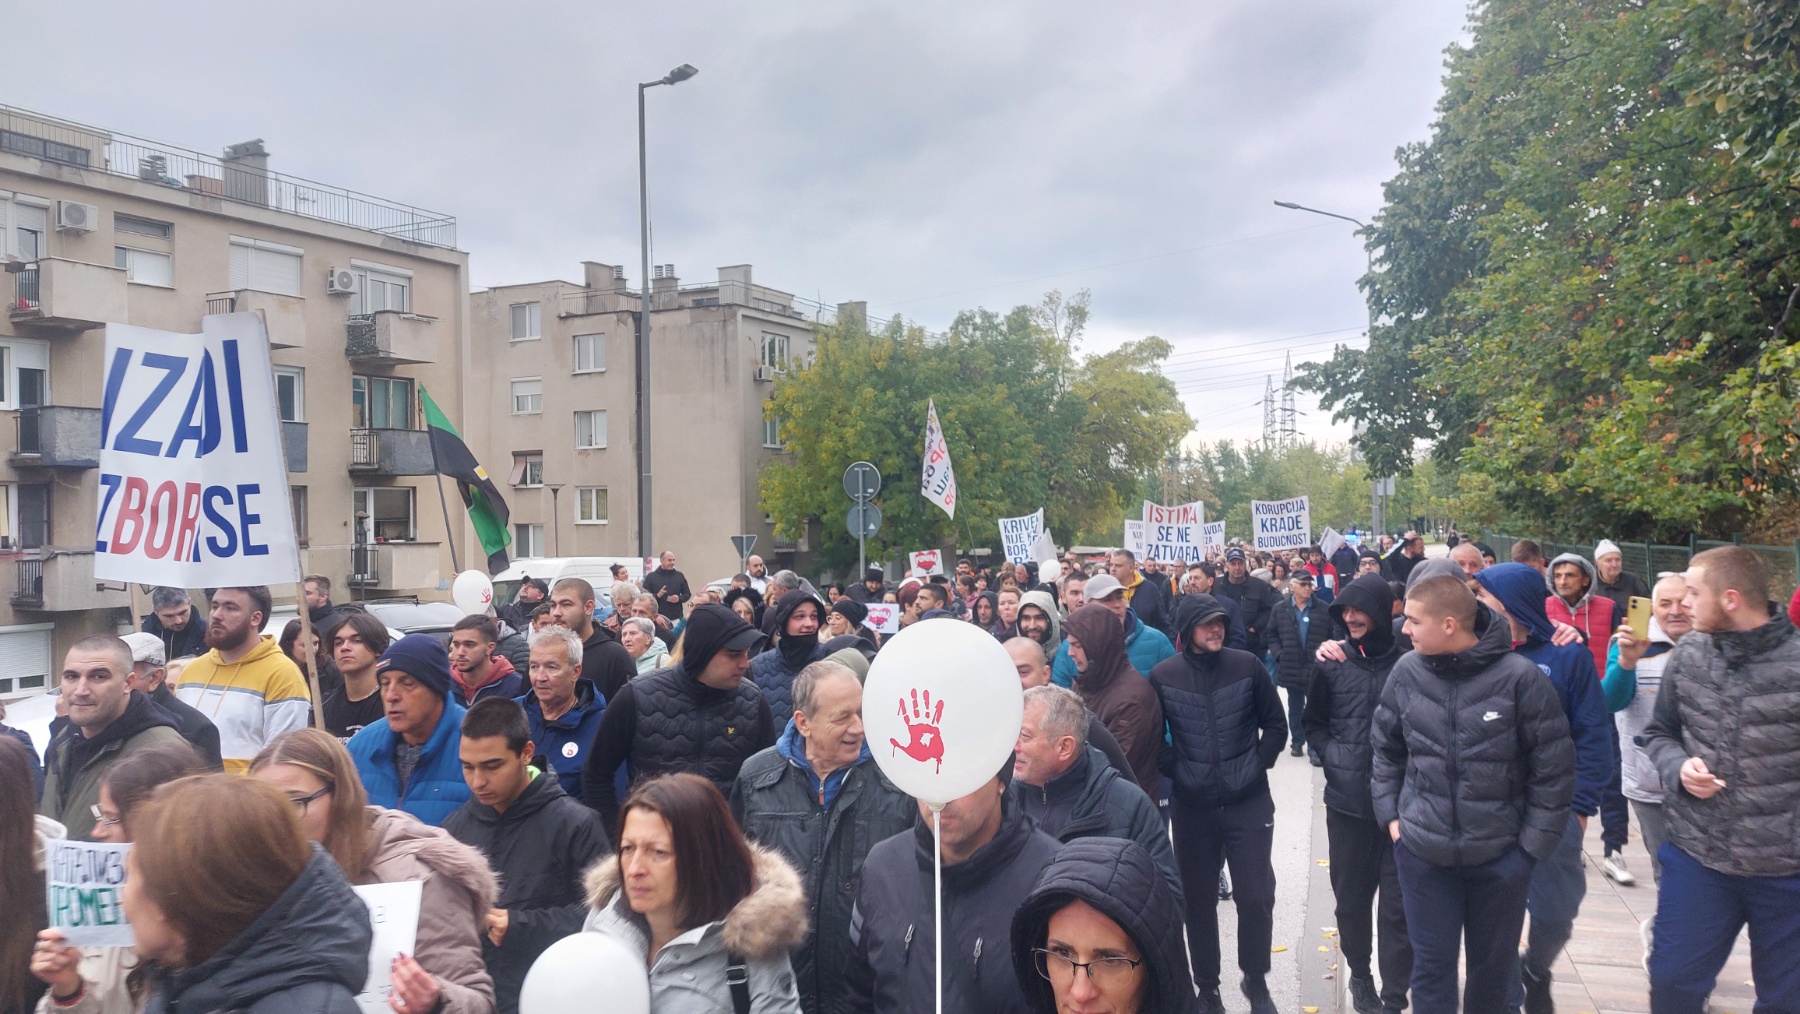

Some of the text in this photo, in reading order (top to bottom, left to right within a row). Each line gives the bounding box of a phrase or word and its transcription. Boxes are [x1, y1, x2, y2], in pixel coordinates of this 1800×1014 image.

[1149, 504, 1198, 525] ISTINA
[1255, 499, 1306, 515] KORUPCIJA
[96, 474, 269, 563] ZBOR SE
[1260, 514, 1304, 533] KRADE
[1005, 532, 1025, 545] NIJE
[1157, 525, 1174, 542] SE
[1176, 526, 1191, 543] NE
[1147, 543, 1200, 562] ZATVARA
